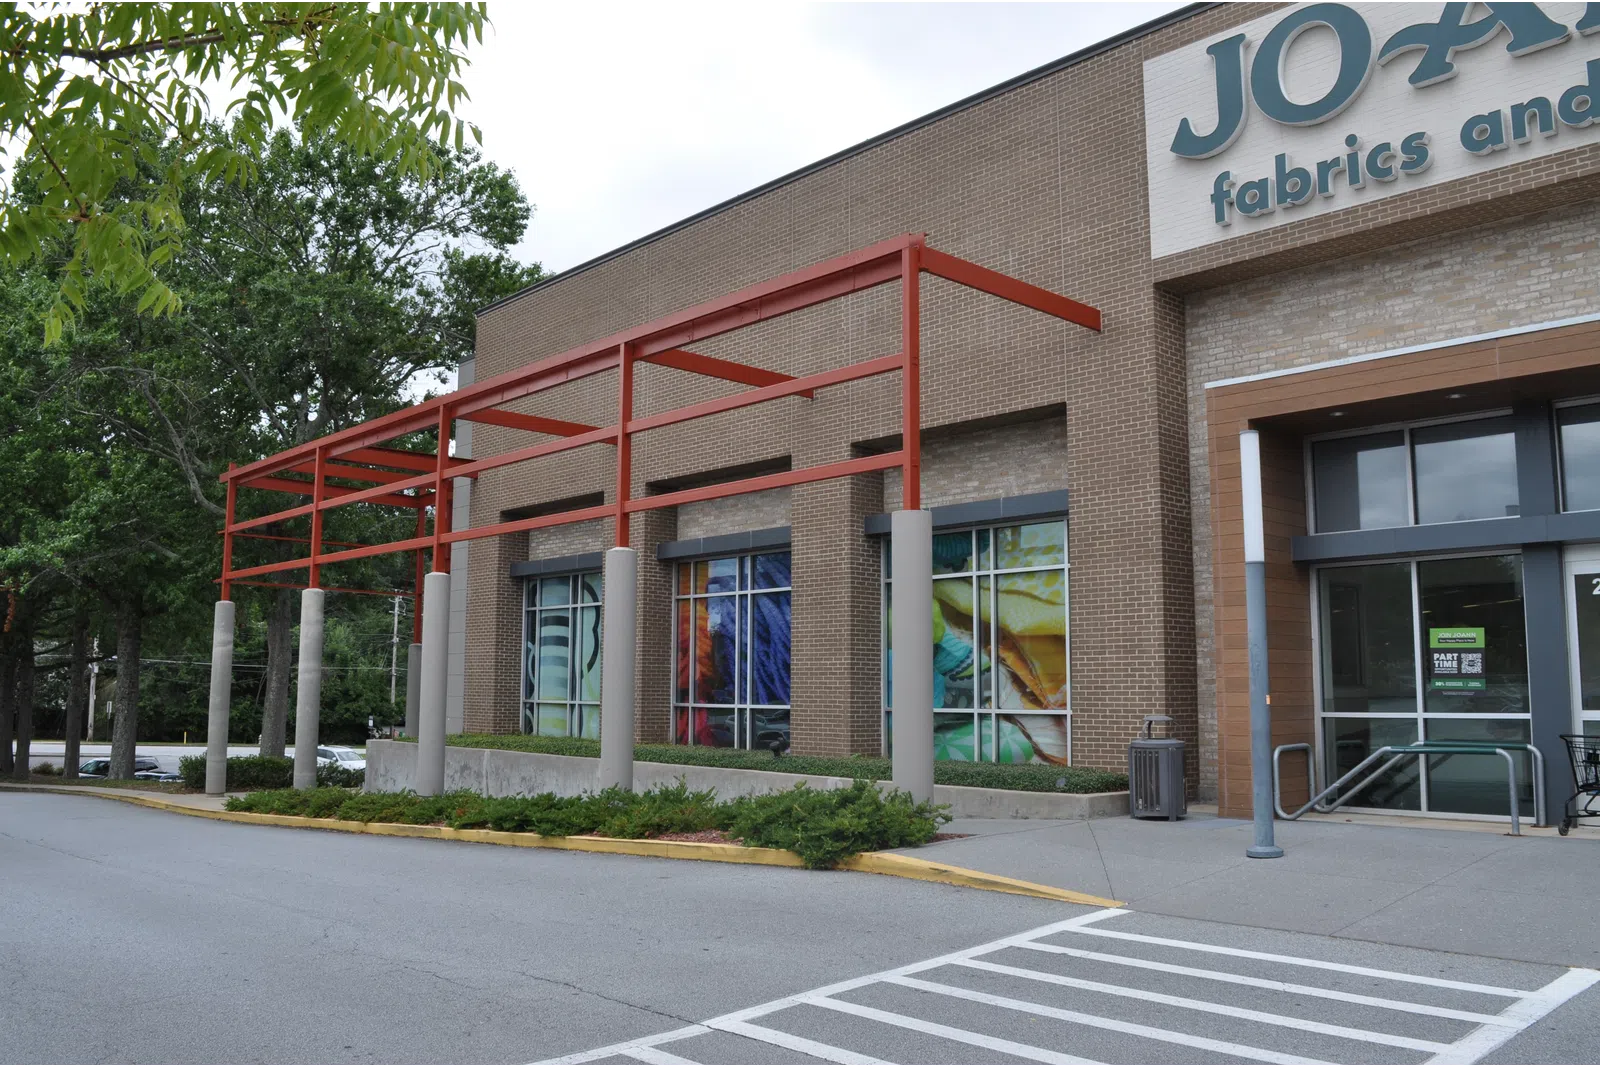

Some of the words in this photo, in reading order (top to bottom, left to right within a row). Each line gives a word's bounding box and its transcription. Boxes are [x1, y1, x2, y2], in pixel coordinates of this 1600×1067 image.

[1169, 0, 1600, 159] JOA
[1210, 131, 1434, 226] fabrics
[1459, 58, 1600, 155] and
